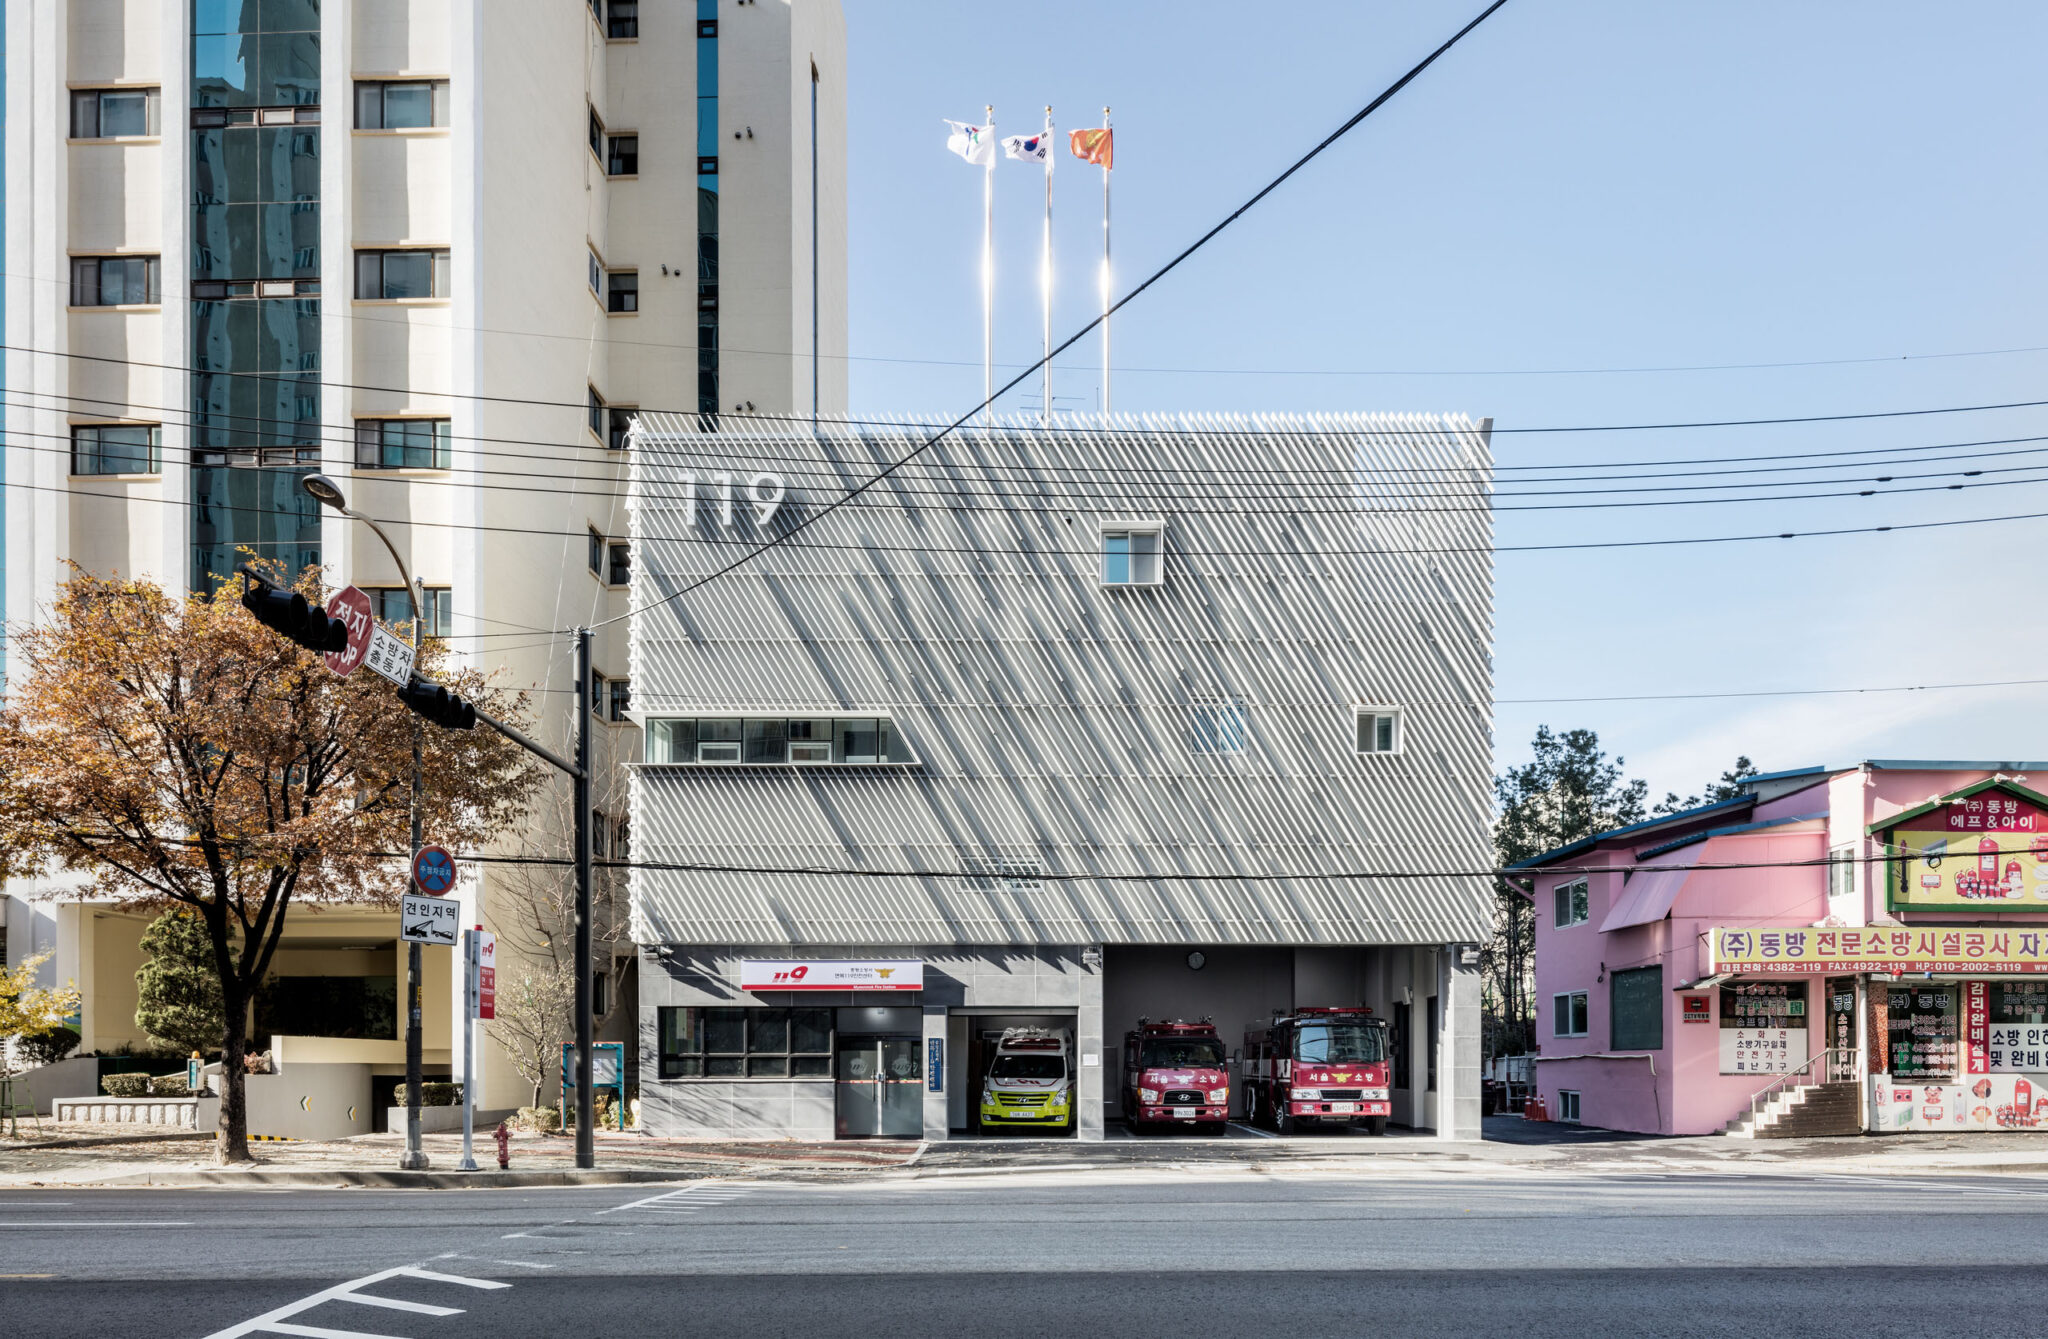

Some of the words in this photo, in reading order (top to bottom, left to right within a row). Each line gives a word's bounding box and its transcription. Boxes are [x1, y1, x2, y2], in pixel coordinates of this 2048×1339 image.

[678, 472, 785, 525] 119
[373, 635, 412, 666] 소방차
[370, 649, 410, 682] 출동시
[405, 902, 456, 920] 견인지역
[1816, 931, 2011, 958] 전문소방시설공사
[2019, 932, 2048, 958] 자
[772, 966, 809, 983] 119
[1833, 993, 1854, 1011] 동방
[1918, 994, 1950, 1009] 동방
[1990, 1050, 2003, 1067] 및
[1150, 1075, 1168, 1084] 서울
[1200, 1075, 1218, 1084] 소방
[1309, 1072, 1329, 1082] 서울
[1354, 1073, 1374, 1082] 소방
